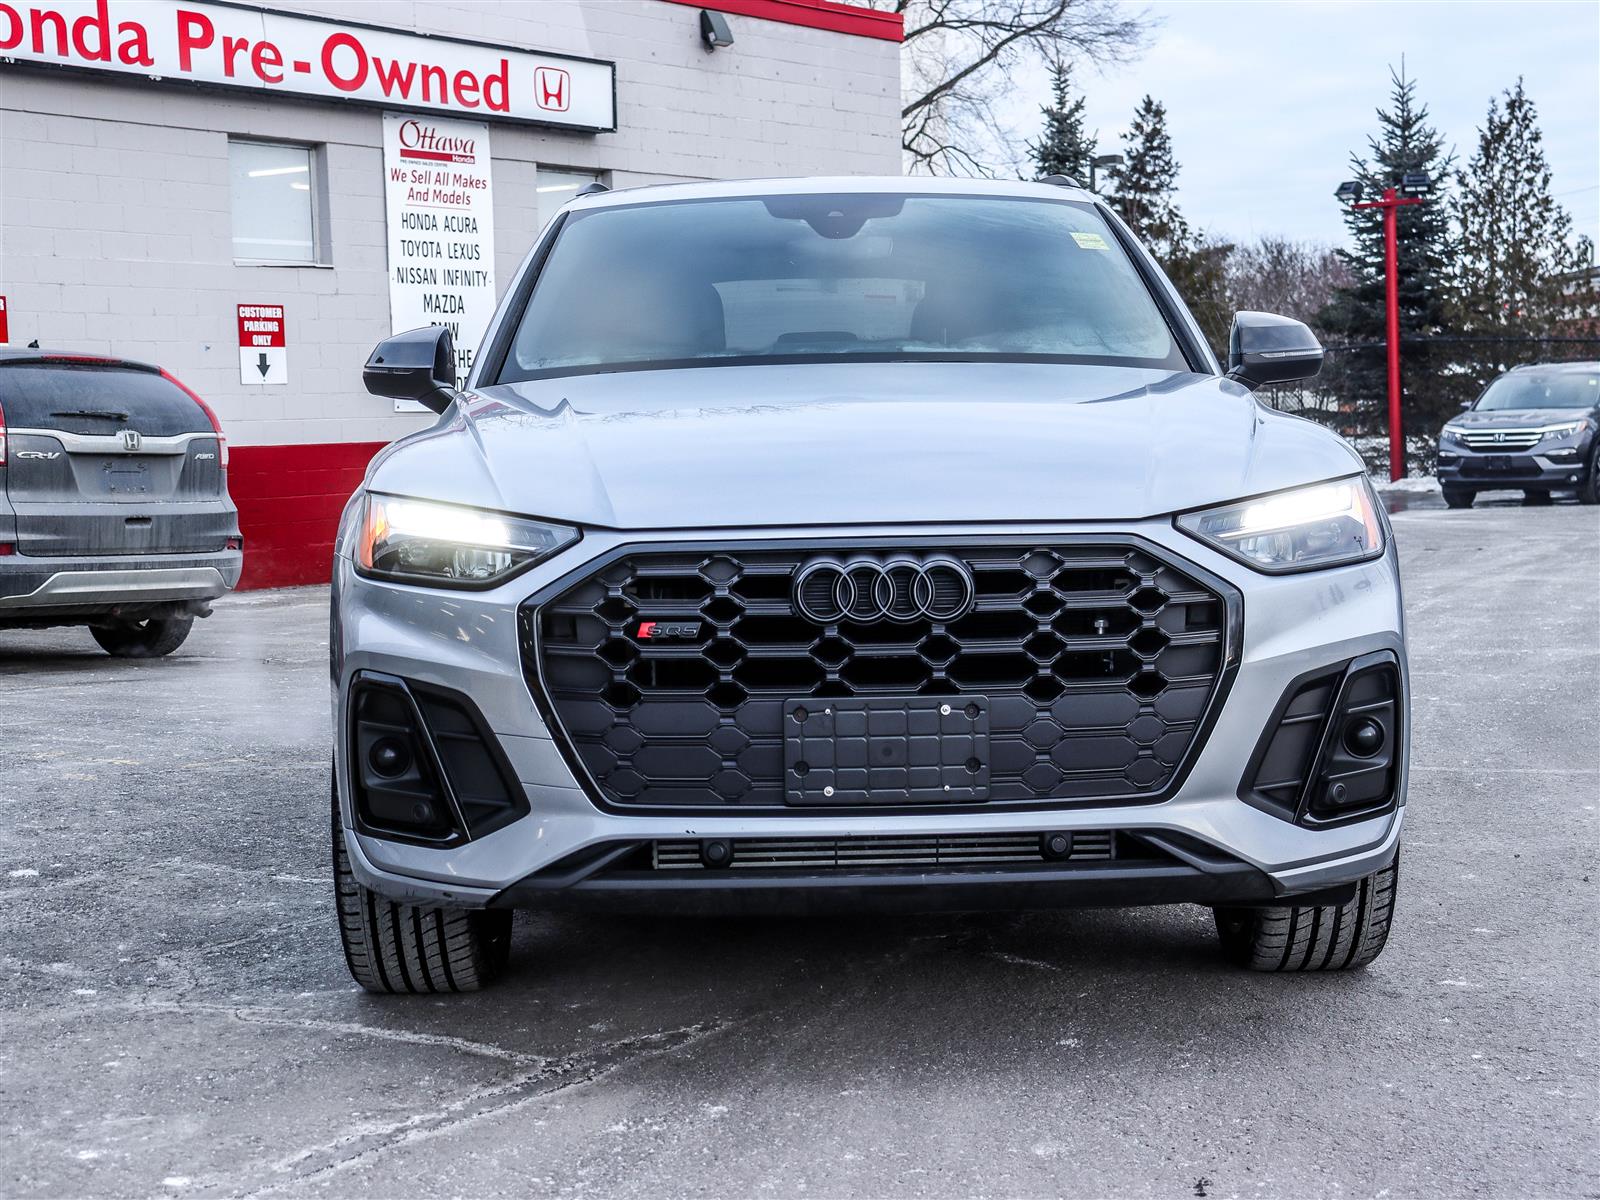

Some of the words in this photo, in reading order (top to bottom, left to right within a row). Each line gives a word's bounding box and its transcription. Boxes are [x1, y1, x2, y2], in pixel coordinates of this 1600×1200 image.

[177, 10, 510, 112] Pre-Owned
[399, 119, 475, 154] Ottawa
[452, 155, 475, 164] Honda
[391, 168, 407, 182] We
[411, 170, 431, 184] Sell
[434, 172, 449, 187] All
[453, 173, 487, 190] Makes
[408, 187, 429, 202] And
[433, 189, 471, 206] Models
[402, 212, 438, 231] HONDA
[444, 215, 478, 234] ACURA
[400, 239, 442, 258] TOYOTA
[448, 242, 480, 261] LEXUS
[397, 266, 437, 285] NISSAN
[444, 269, 488, 288] INFINITY
[239, 306, 283, 318] CUSTOMER
[424, 293, 465, 314] MAZDA
[244, 320, 279, 332] PARKING
[252, 334, 272, 346] ONLY
[16, 451, 60, 460] CR-V
